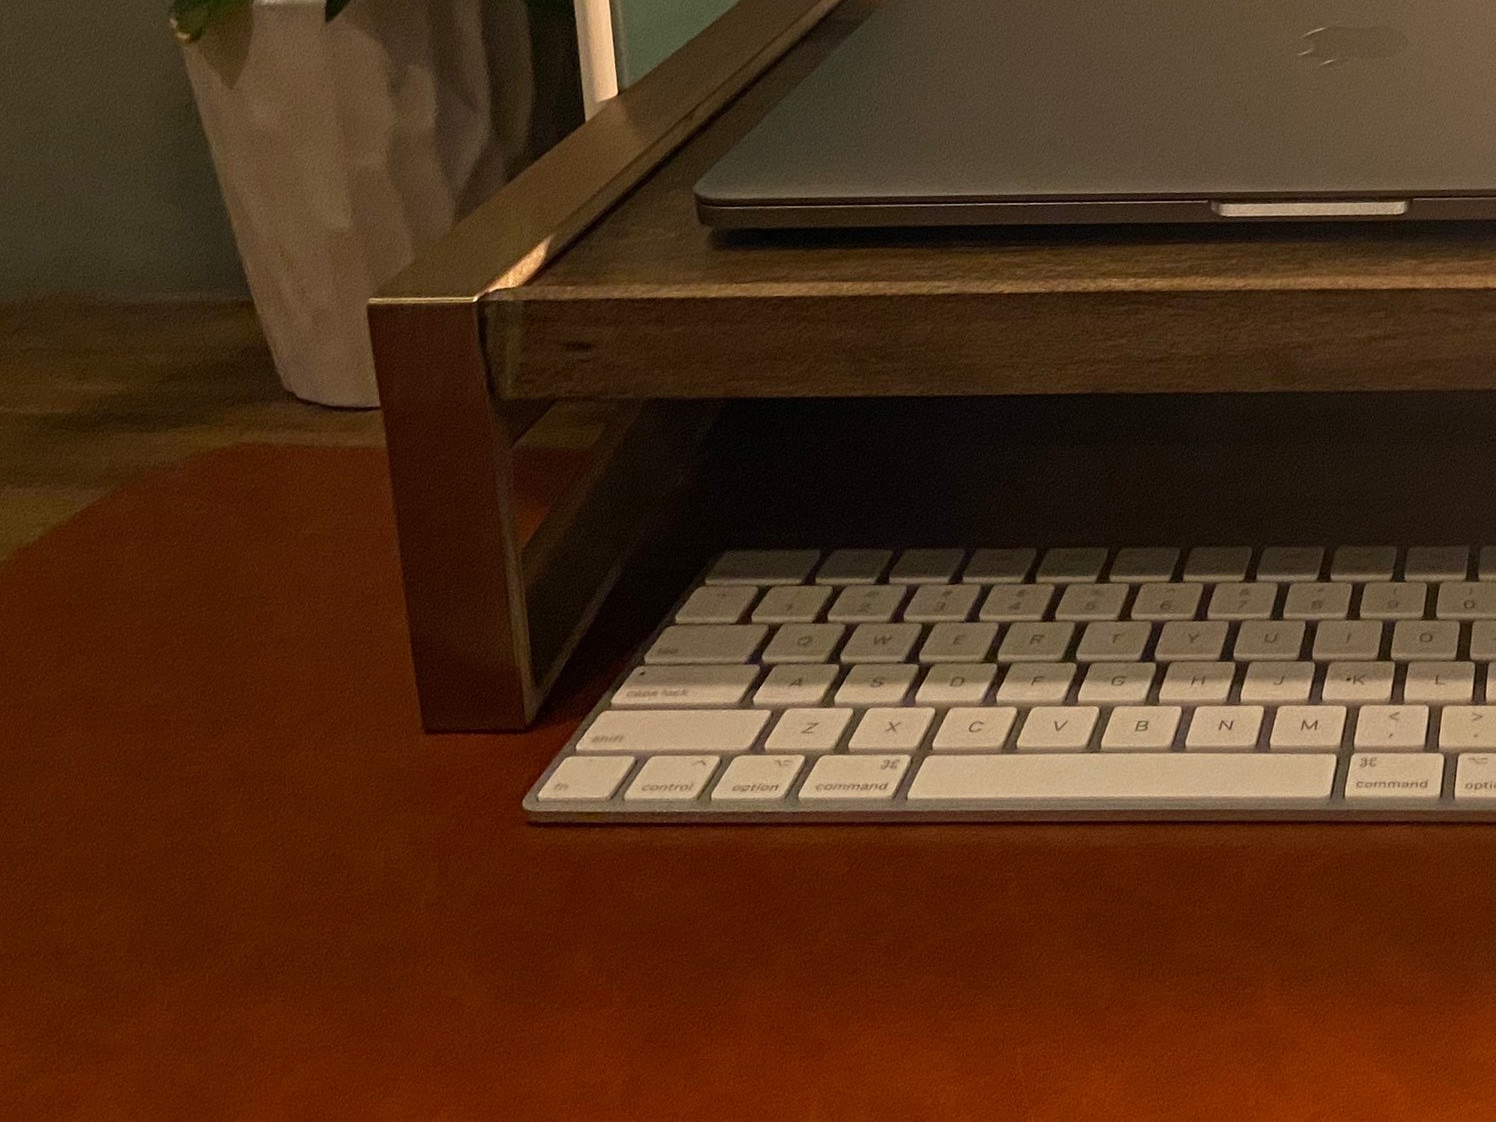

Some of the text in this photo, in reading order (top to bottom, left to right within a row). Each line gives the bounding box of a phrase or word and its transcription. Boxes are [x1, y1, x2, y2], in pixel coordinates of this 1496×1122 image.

[797, 634, 814, 647] Q
[873, 634, 893, 646] W
[953, 633, 968, 645] E
[1029, 633, 1045, 645] R
[1112, 633, 1127, 645] T
[1187, 633, 1200, 645] Y
[1264, 633, 1279, 645] U
[788, 676, 803, 687] A
[869, 676, 885, 688] S
[949, 676, 965, 688] D
[1031, 675, 1045, 686] F
[1111, 675, 1127, 687] G
[1190, 675, 1206, 686] H
[1273, 675, 1285, 686] J
[1351, 674, 1366, 686] K
[1434, 674, 1447, 686] L
[801, 721, 819, 734] Z
[885, 721, 902, 734] X
[968, 720, 984, 734] C
[1053, 720, 1068, 733] V
[1135, 720, 1149, 733] B
[1218, 719, 1234, 732] N
[1300, 719, 1319, 732] M
[590, 733, 625, 744] shift
[641, 781, 694, 792] control
[732, 782, 779, 793] option
[815, 781, 889, 793] command
[1355, 779, 1429, 790] command
